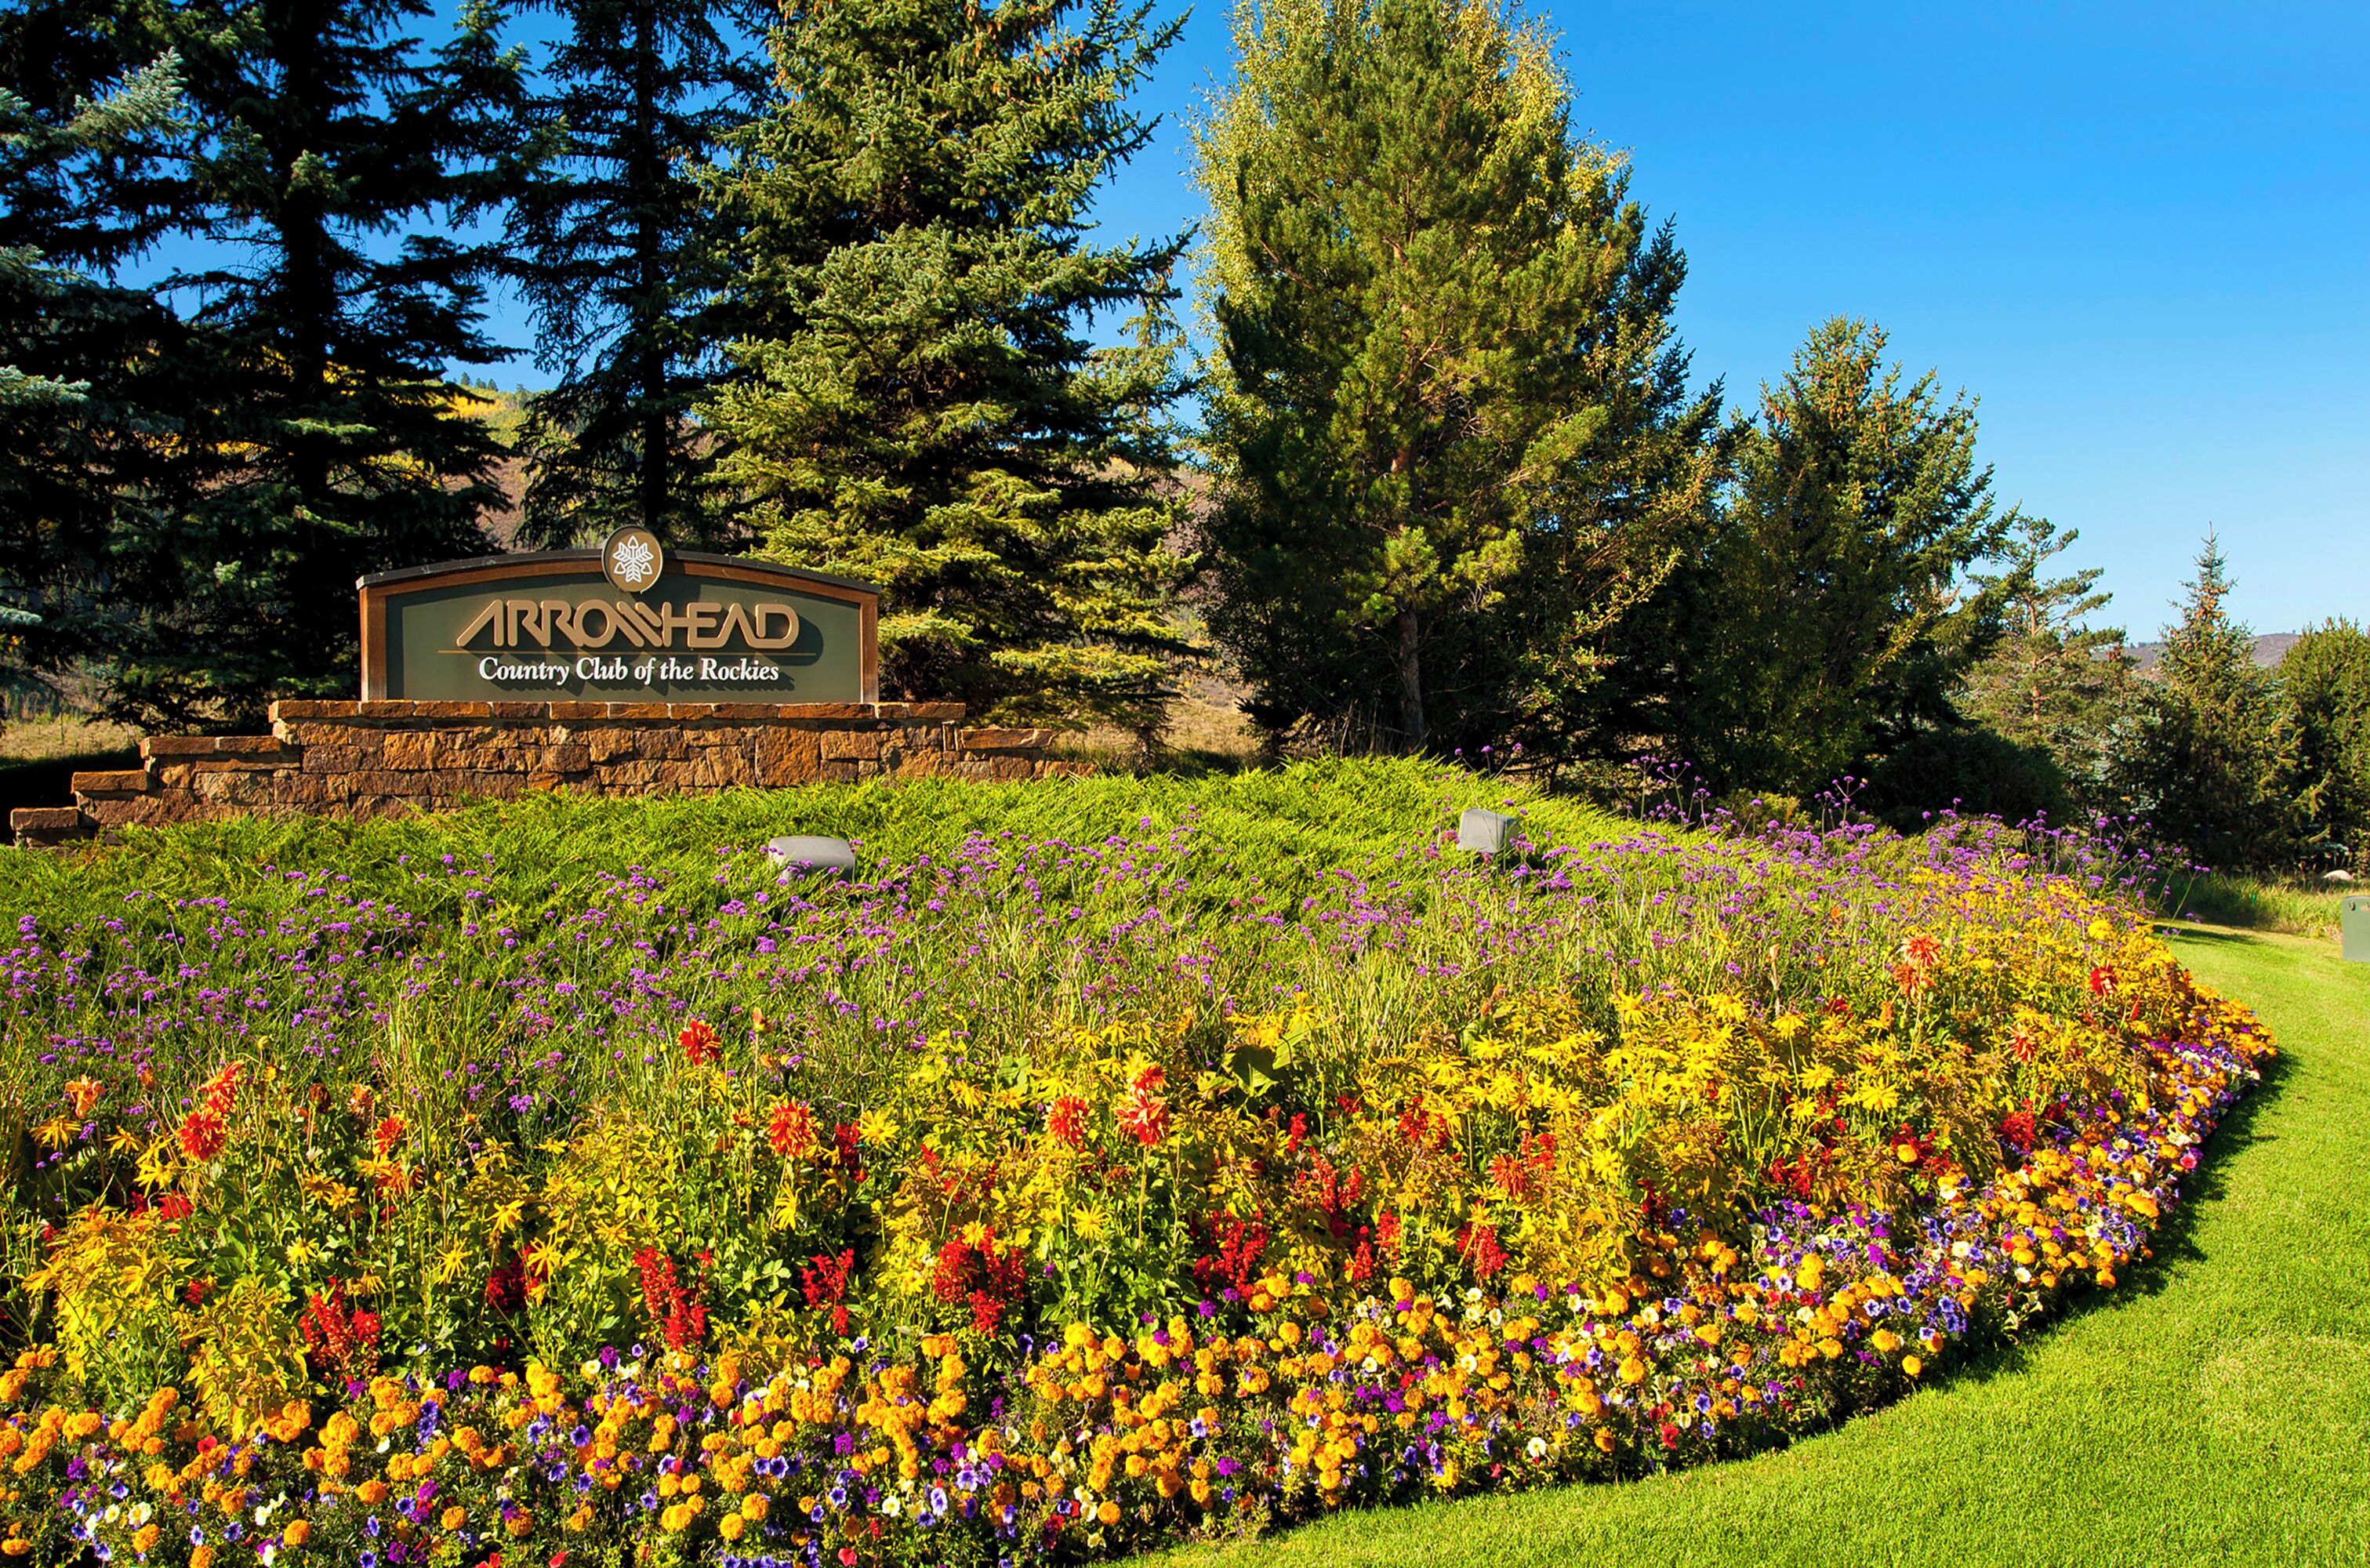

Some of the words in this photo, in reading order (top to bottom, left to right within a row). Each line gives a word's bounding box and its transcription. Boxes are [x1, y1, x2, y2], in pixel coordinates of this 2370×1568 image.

[456, 598, 799, 648] ARROWHEAD
[479, 657, 569, 684] Country
[576, 657, 629, 681] Club
[634, 658, 655, 685] of
[659, 658, 694, 681] the
[700, 658, 780, 681] Rockies
